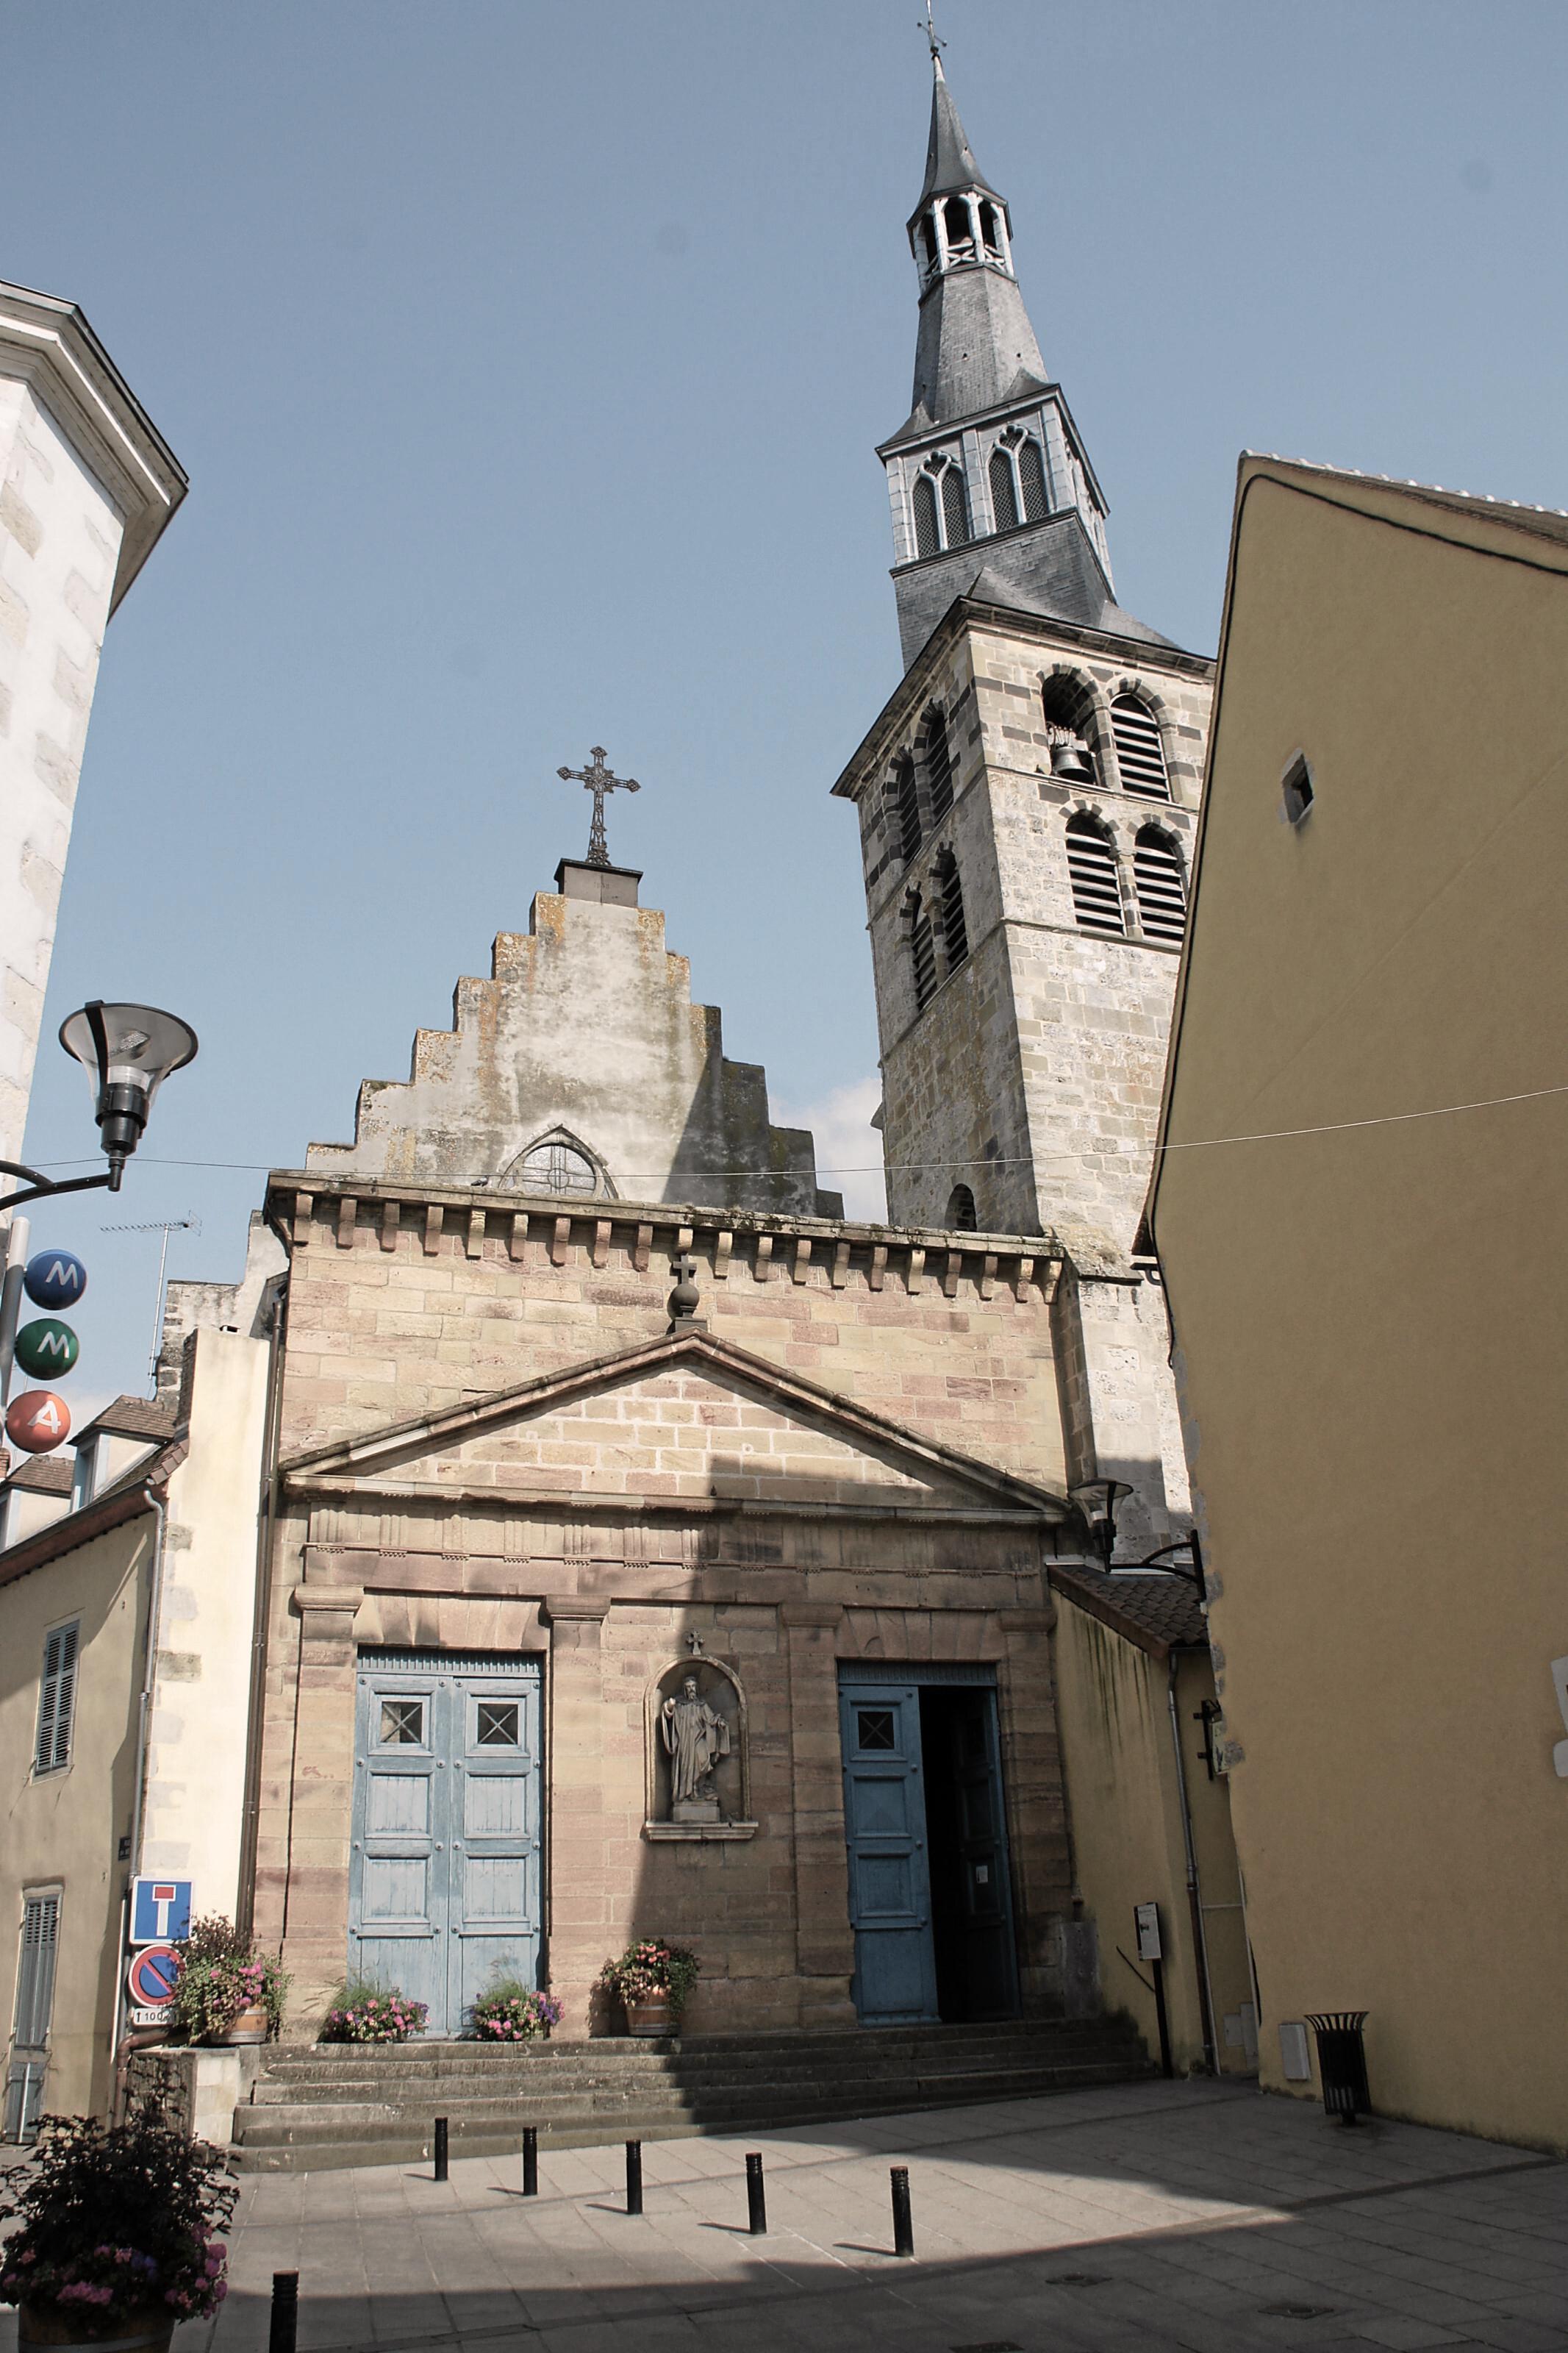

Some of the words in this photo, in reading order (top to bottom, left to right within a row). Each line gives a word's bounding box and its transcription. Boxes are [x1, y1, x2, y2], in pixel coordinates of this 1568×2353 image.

[46, 1260, 78, 1288] M
[37, 1331, 69, 1359] M
[28, 1400, 62, 1433] A
